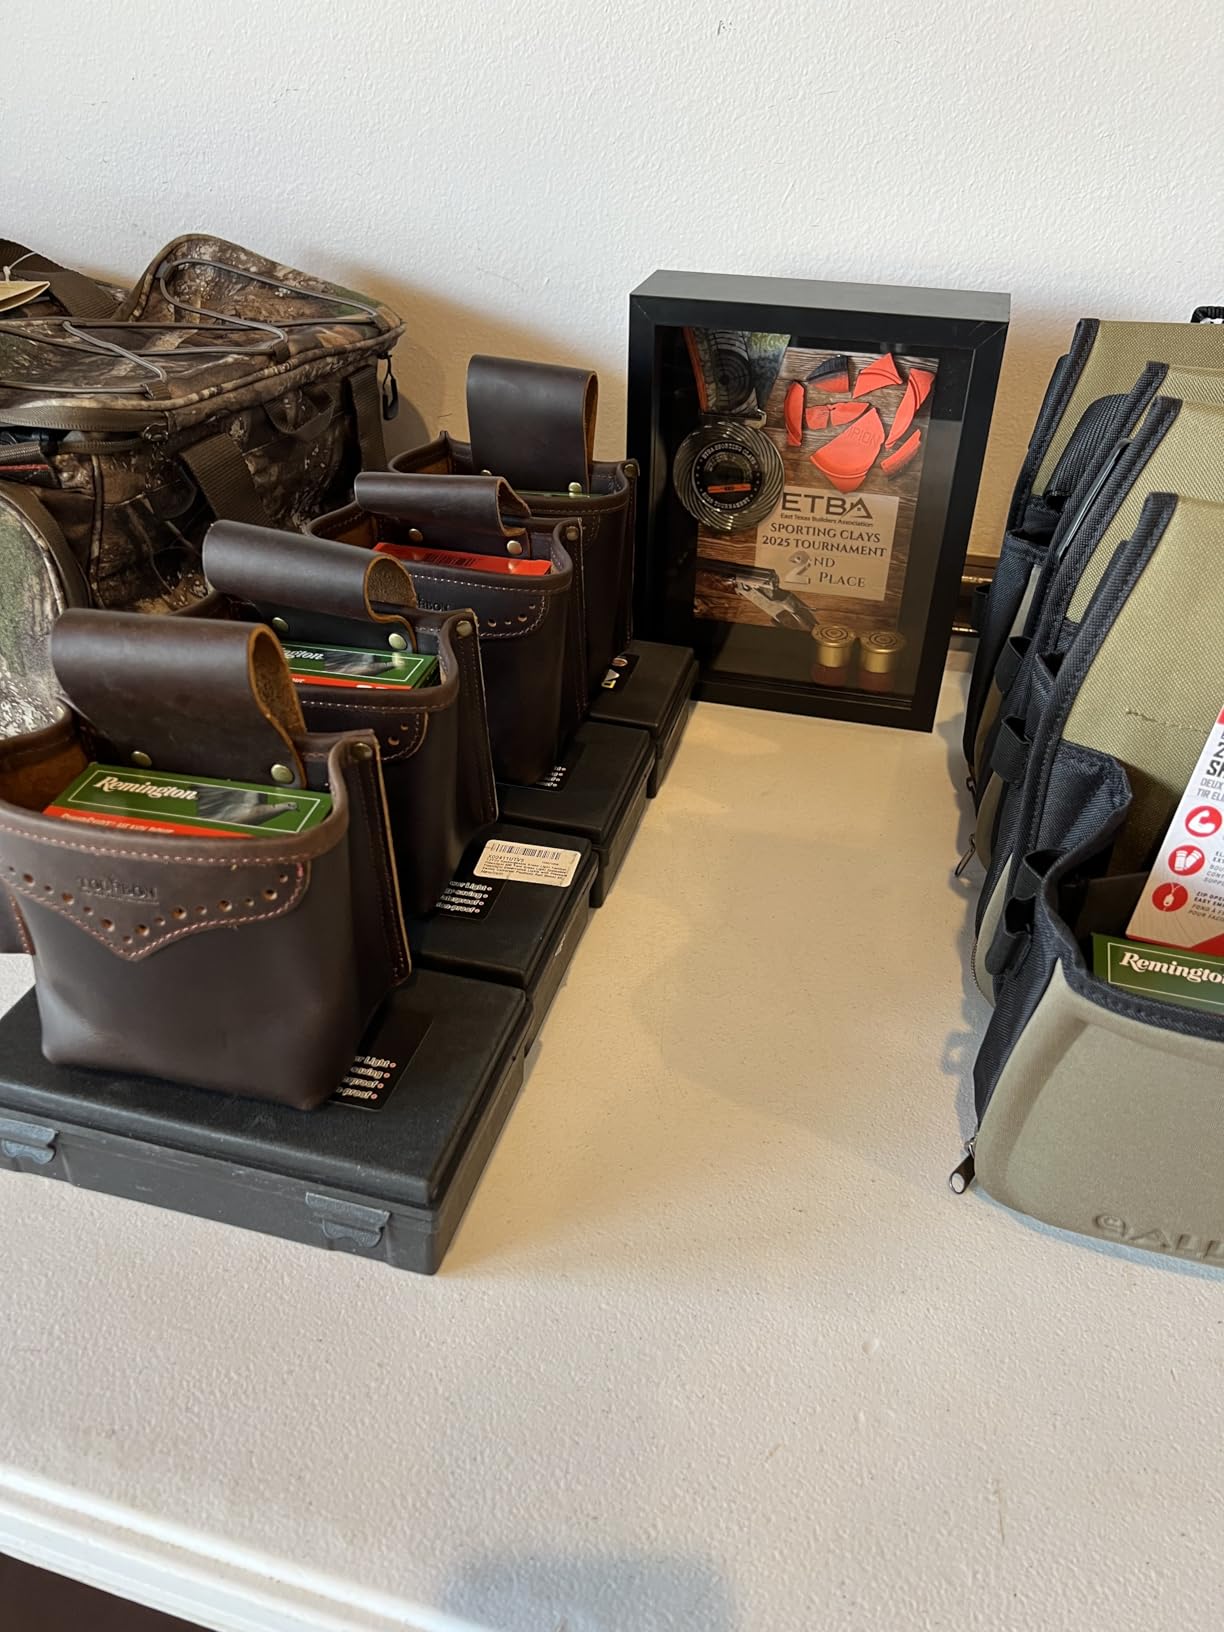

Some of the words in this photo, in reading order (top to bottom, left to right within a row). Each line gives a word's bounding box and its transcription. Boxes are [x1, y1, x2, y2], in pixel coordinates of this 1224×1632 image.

[781, 492, 873, 520] ETBA
[770, 522, 837, 539] SPORTING
[840, 529, 881, 543] CLAYS
[762, 535, 790, 548] 2025
[793, 538, 888, 558] TOURNAMENT
[819, 571, 866, 588] PLACE
[363, 1055, 391, 1069] Light
